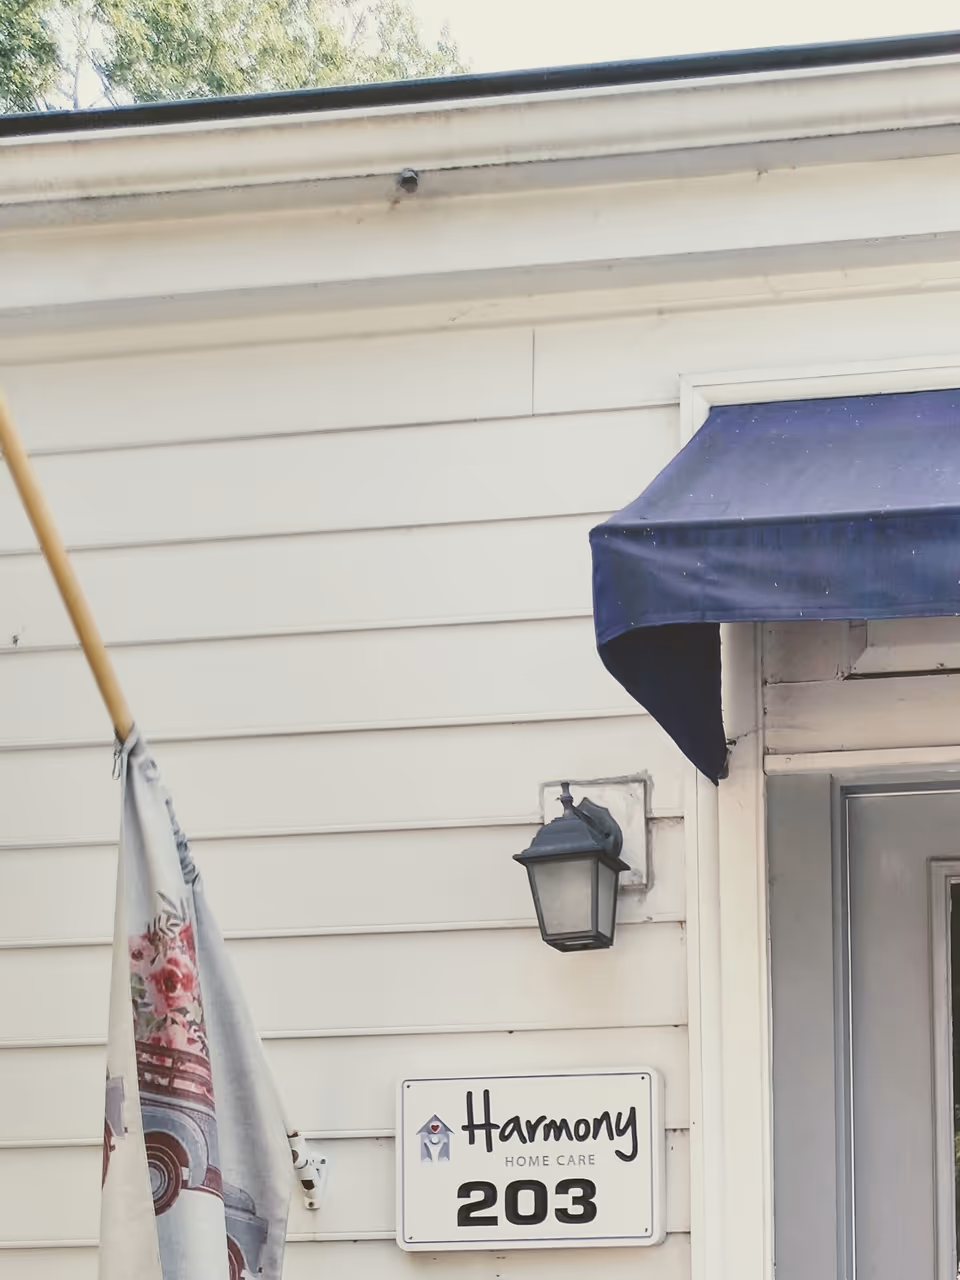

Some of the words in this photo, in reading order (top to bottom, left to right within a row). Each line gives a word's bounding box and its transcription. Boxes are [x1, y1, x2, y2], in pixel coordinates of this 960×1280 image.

[461, 1088, 638, 1162] Harmony
[505, 1155, 549, 1168] HOME
[556, 1154, 596, 1166] CARE
[456, 1178, 598, 1227] 203
